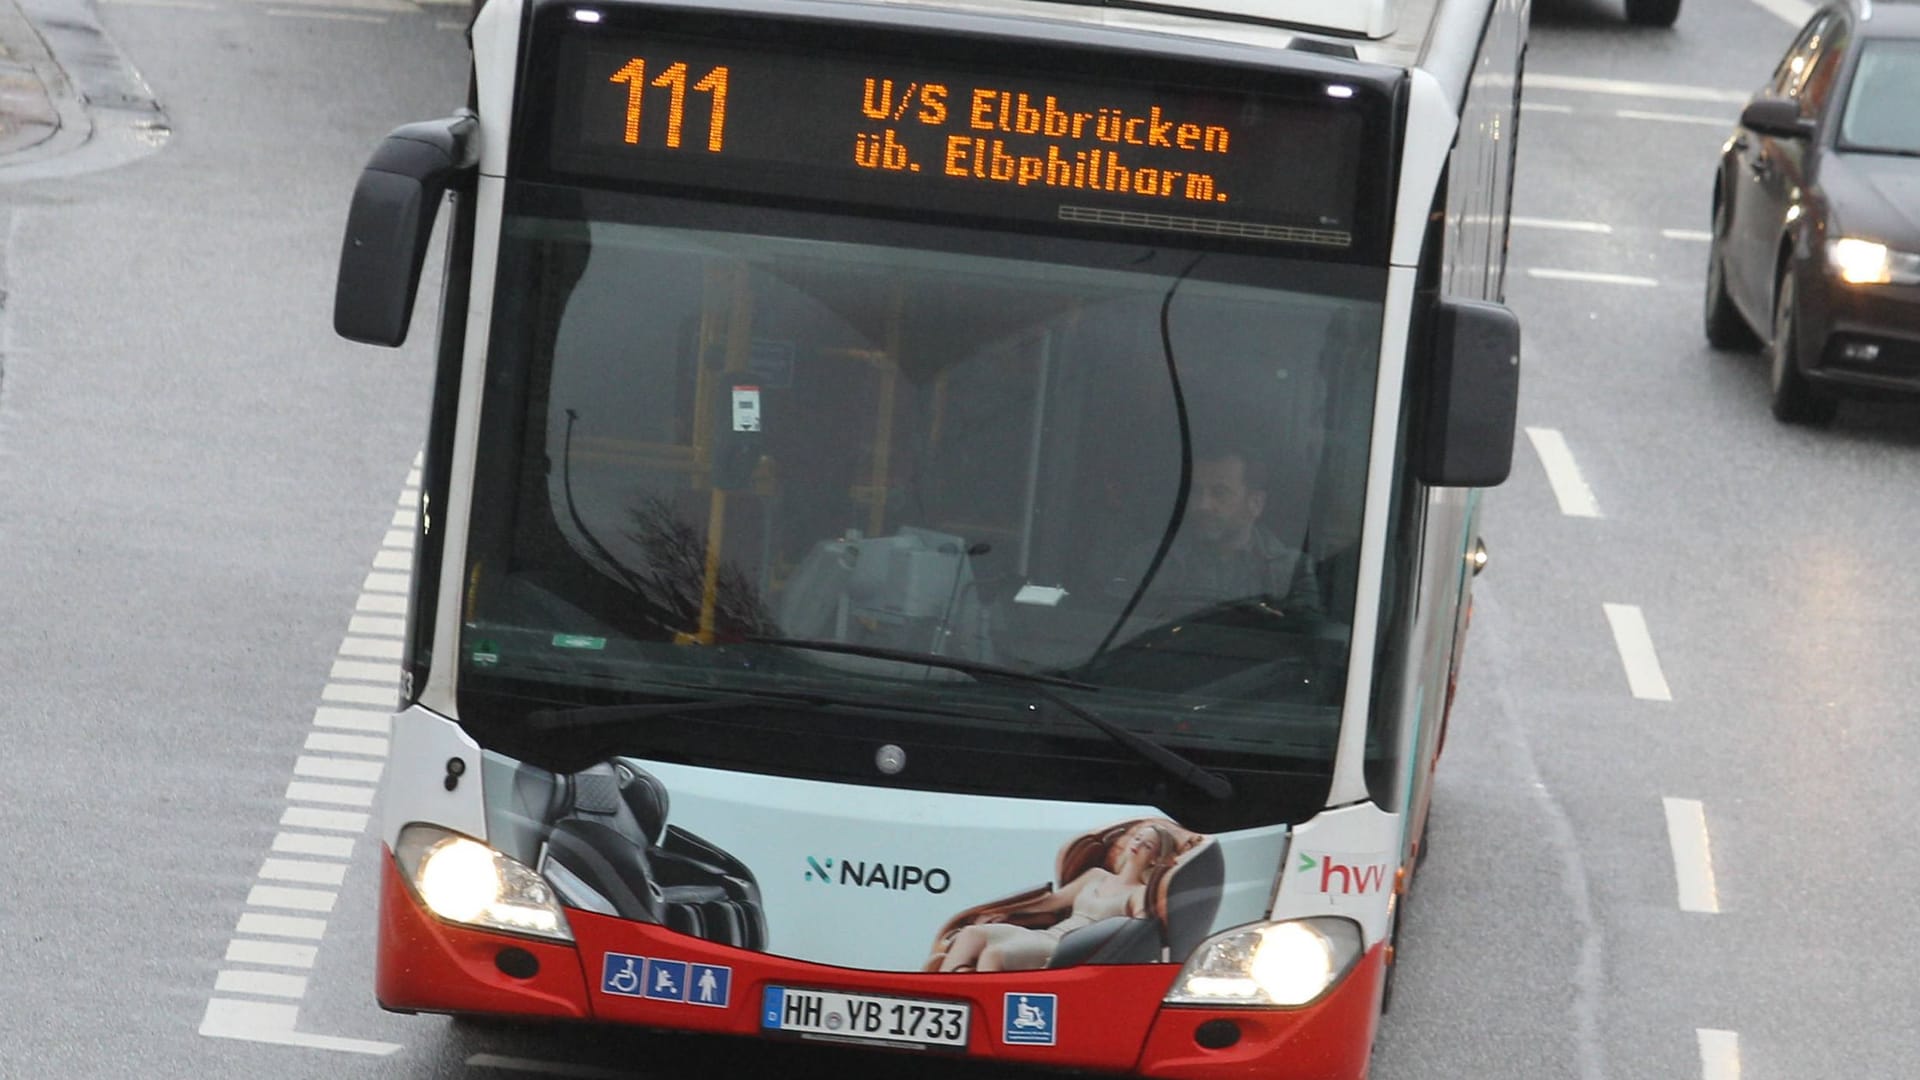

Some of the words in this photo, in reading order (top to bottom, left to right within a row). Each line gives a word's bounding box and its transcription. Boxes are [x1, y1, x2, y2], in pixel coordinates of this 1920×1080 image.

[609, 57, 729, 152] 111
[862, 77, 948, 125] U/S
[970, 88, 1230, 153] Elbbrücken
[854, 129, 921, 172] üb.
[944, 134, 1228, 203] Elbphilharm.
[840, 860, 951, 894] NAIPO
[784, 994, 823, 1028] HH
[847, 999, 882, 1032] YB
[889, 1004, 964, 1040] 1733
